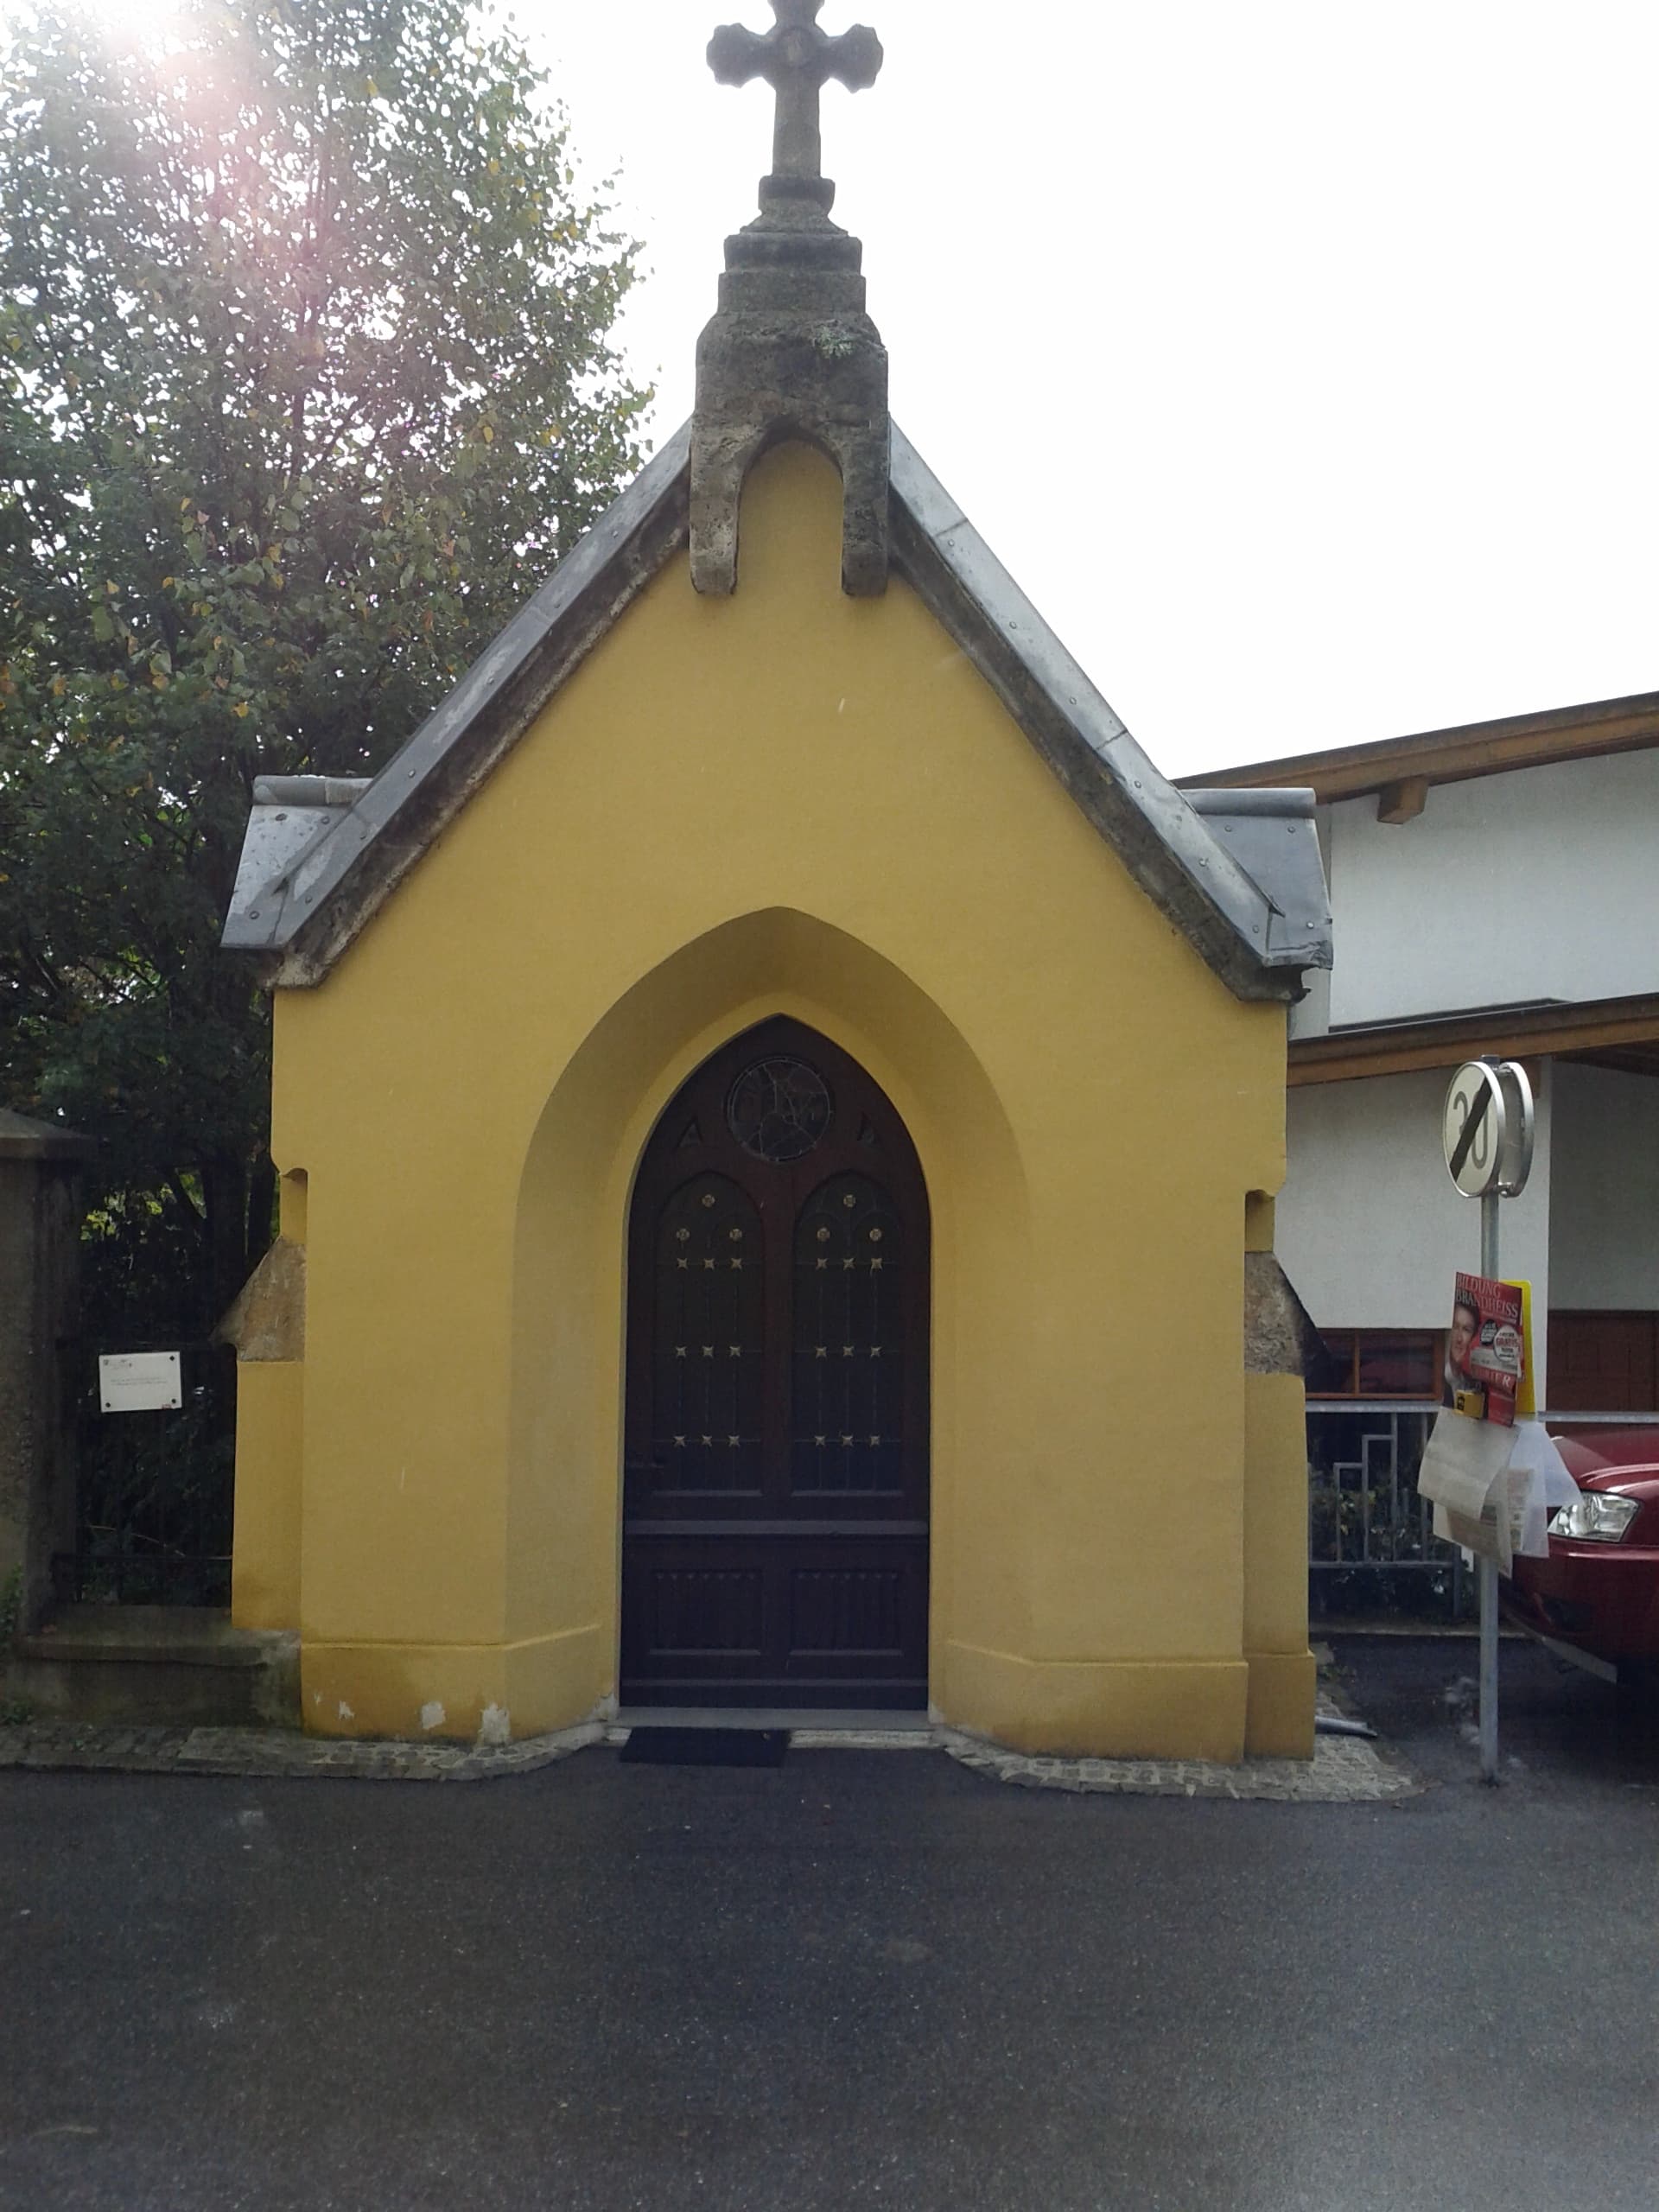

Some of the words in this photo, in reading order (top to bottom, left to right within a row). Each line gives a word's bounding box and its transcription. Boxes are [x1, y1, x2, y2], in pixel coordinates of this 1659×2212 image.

[1452, 1090, 1489, 1169] 30
[1456, 1274, 1502, 1299] BILDUNG
[1455, 1288, 1519, 1319] BRANDHEISS
